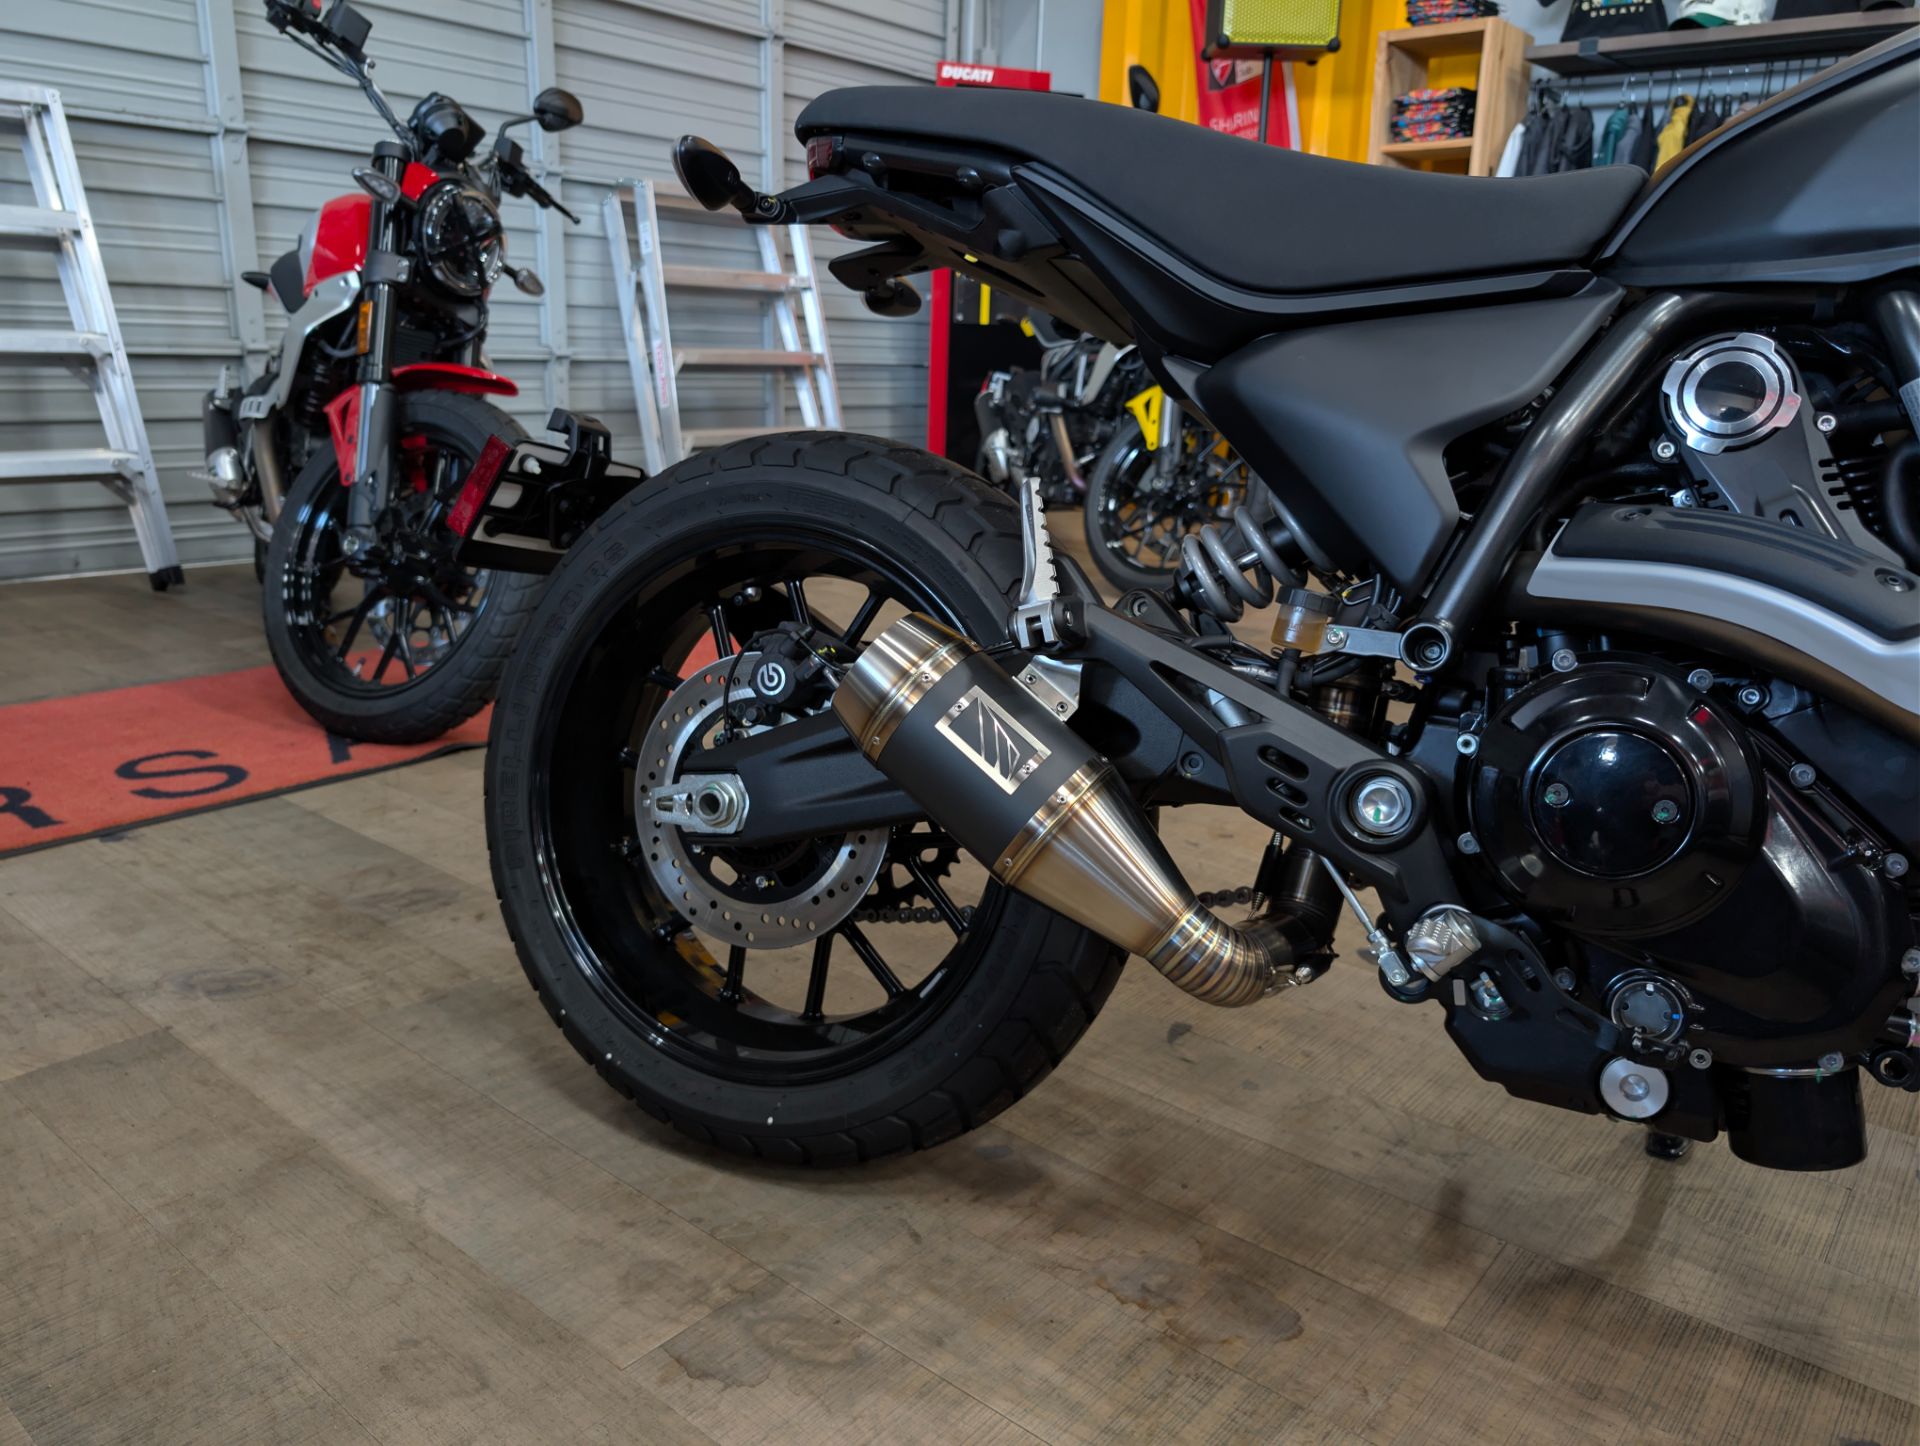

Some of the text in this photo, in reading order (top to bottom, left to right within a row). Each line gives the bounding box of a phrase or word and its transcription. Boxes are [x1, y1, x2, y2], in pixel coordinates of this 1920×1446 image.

[1590, 6, 1644, 18] DUCATI
[941, 64, 995, 84] DUCATI
[1209, 107, 1260, 132] SHARIN
